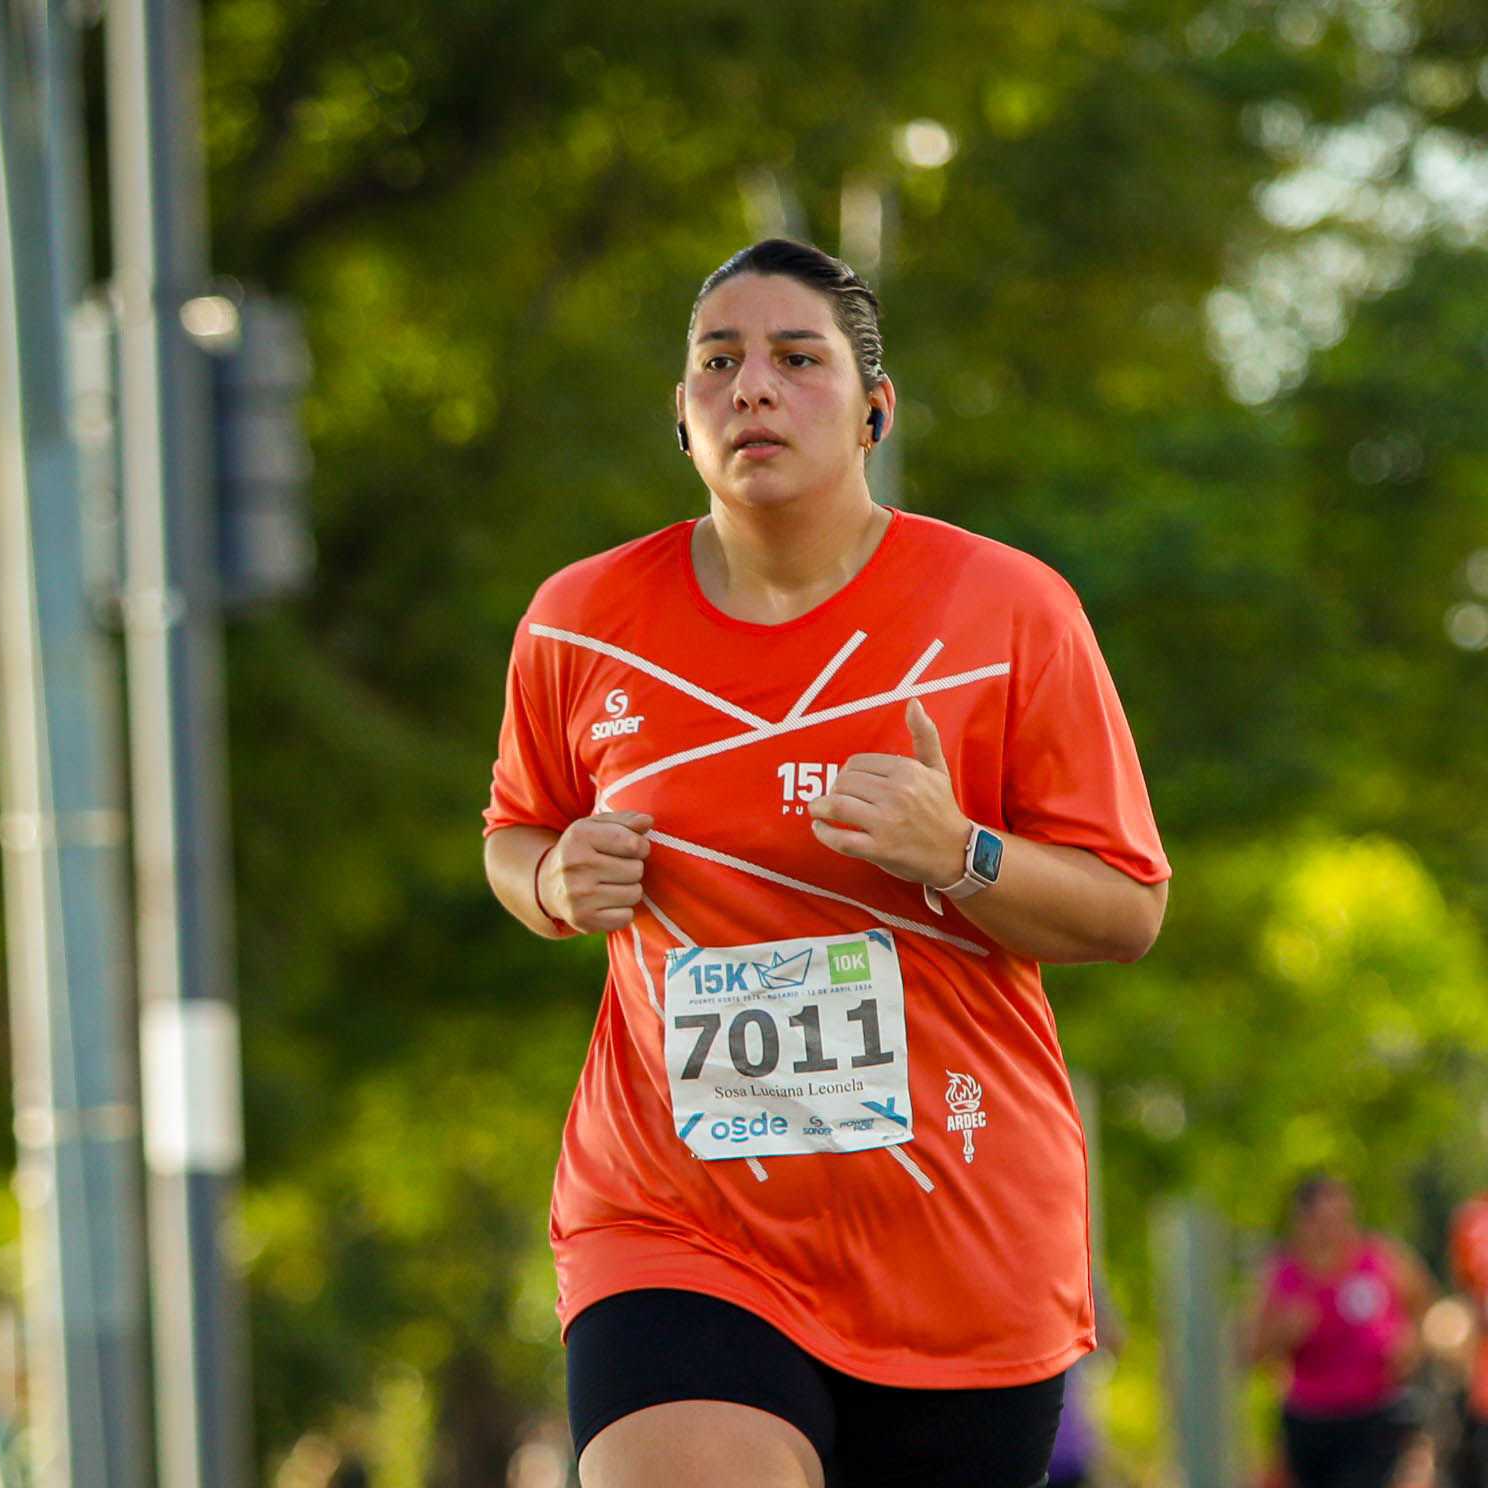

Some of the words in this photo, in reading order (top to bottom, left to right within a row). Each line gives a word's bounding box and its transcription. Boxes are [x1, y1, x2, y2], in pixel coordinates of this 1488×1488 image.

[833, 952, 865, 973] 10K
[689, 962, 749, 995] 15K
[674, 998, 894, 1079] 7011
[715, 1085, 747, 1099] Sosa
[750, 1084, 803, 1098] Luciana
[808, 1078, 864, 1096] Leonela
[711, 1112, 788, 1141] osde
[947, 1112, 987, 1132] ARDEC
